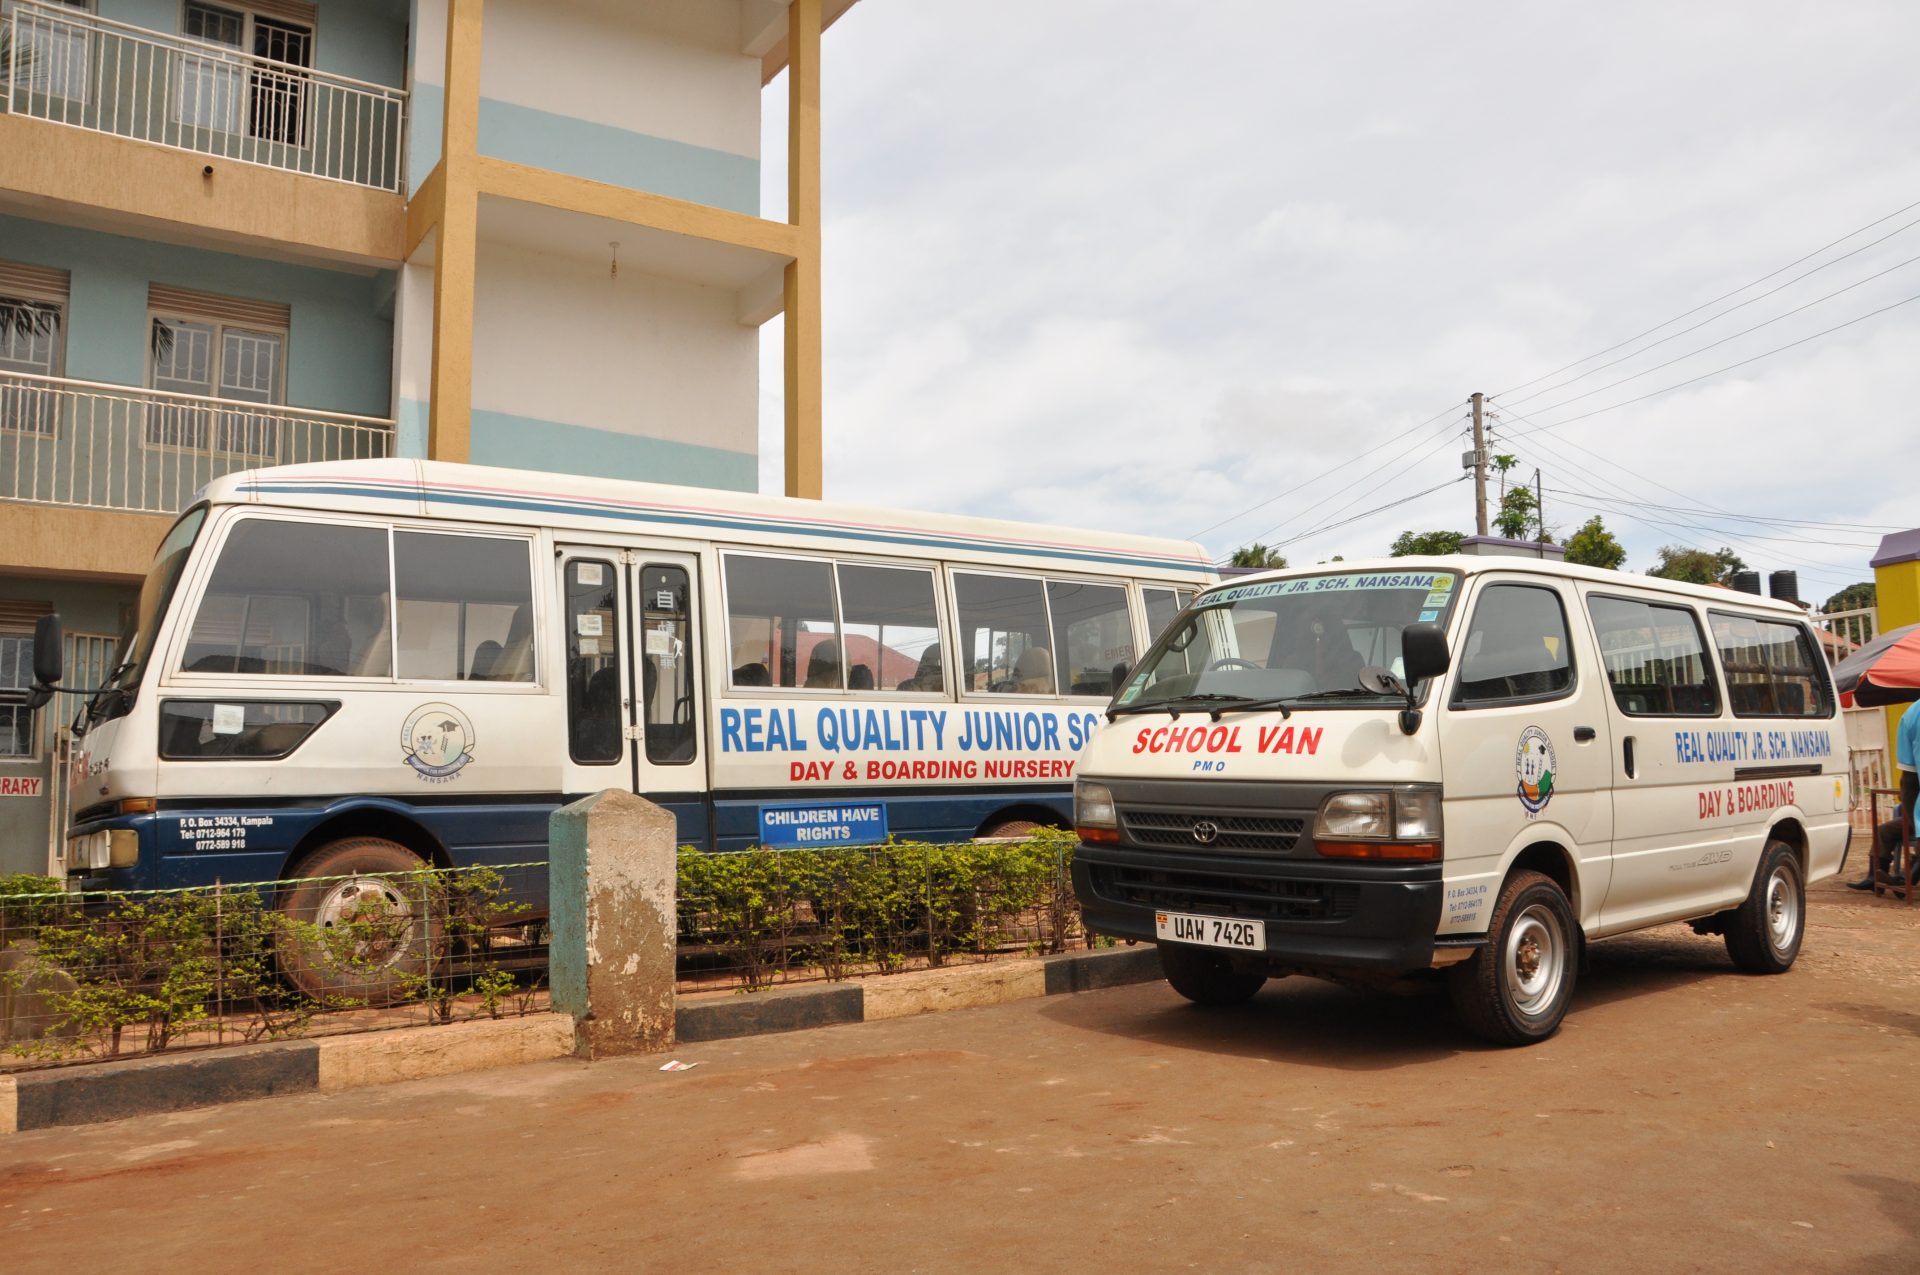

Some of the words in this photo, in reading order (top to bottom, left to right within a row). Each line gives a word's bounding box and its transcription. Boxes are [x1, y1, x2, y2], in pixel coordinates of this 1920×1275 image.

[1227, 583, 1287, 600] QUALITY
[1288, 581, 1309, 593] JR.
[1315, 578, 1349, 590] SCH.
[1355, 575, 1434, 588] NANSANA
[720, 707, 807, 753] REAL
[817, 707, 947, 754] QUALITY
[958, 711, 1061, 752] JUNIOR
[1067, 712, 1102, 752] SC
[1132, 726, 1242, 754] SCHOOL
[1257, 726, 1324, 755] VAN
[1675, 732, 1704, 763] REAL
[1707, 731, 1747, 763] QUALITY
[1752, 731, 1767, 760] JR.
[1769, 731, 1790, 759] SCH.
[1791, 730, 1831, 758] NANSANA
[417, 772, 461, 784] NANSANA
[790, 760, 835, 782] DAY
[842, 761, 858, 780] &
[867, 760, 977, 780] BOARDING
[984, 760, 1075, 779] NURSERY
[0, 778, 40, 795] RARY
[1699, 790, 1722, 819] DAY
[1727, 789, 1735, 815] &
[1737, 781, 1794, 813] BOARDING
[180, 818, 187, 827] P.
[188, 818, 197, 827] O.
[198, 817, 213, 827] Box
[214, 816, 240, 827] 34334,
[241, 816, 273, 827] Kampala
[765, 809, 838, 825] CHILDREN
[842, 807, 879, 822] HAVE
[180, 830, 195, 839] Tel:
[196, 828, 230, 839] 0712-964
[232, 828, 246, 837] 179
[796, 825, 851, 841] RIGHTS
[232, 839, 246, 849] 918
[1175, 917, 1204, 941] UAW
[1213, 921, 1255, 946] 742G
